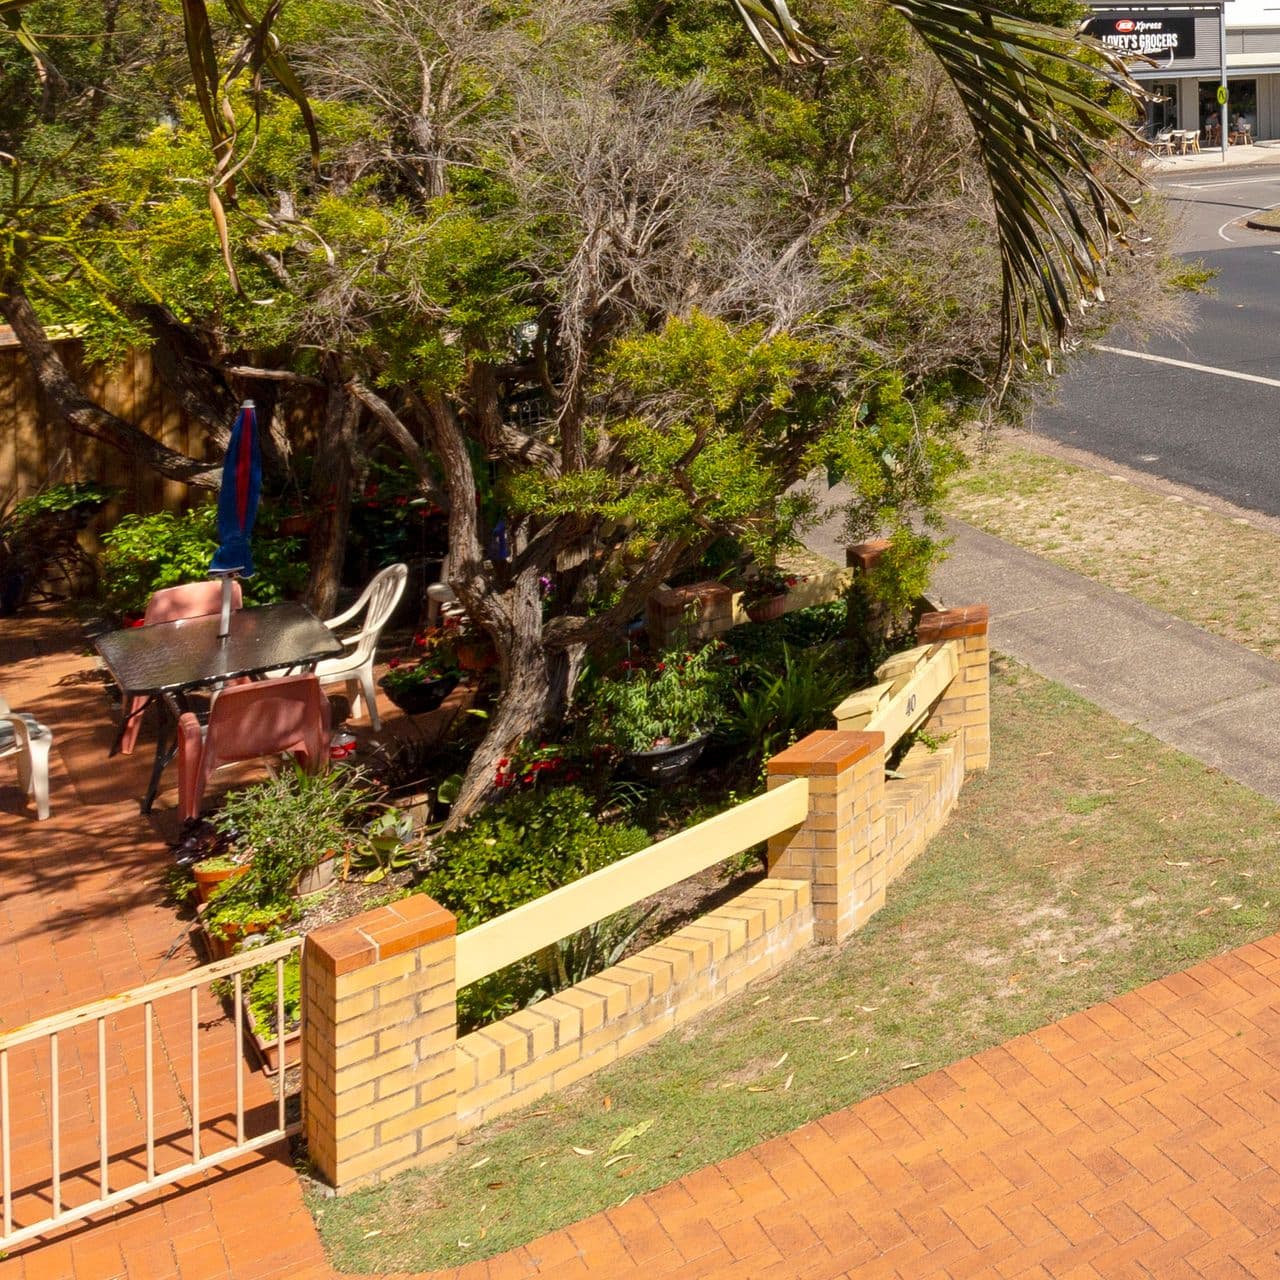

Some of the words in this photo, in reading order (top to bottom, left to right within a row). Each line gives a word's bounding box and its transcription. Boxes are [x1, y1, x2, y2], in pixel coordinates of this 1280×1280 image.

[1135, 21, 1162, 32] Xpress
[1102, 34, 1138, 49] LOVEY'S
[1139, 33, 1178, 48] GROCERS
[905, 694, 916, 716] 40
